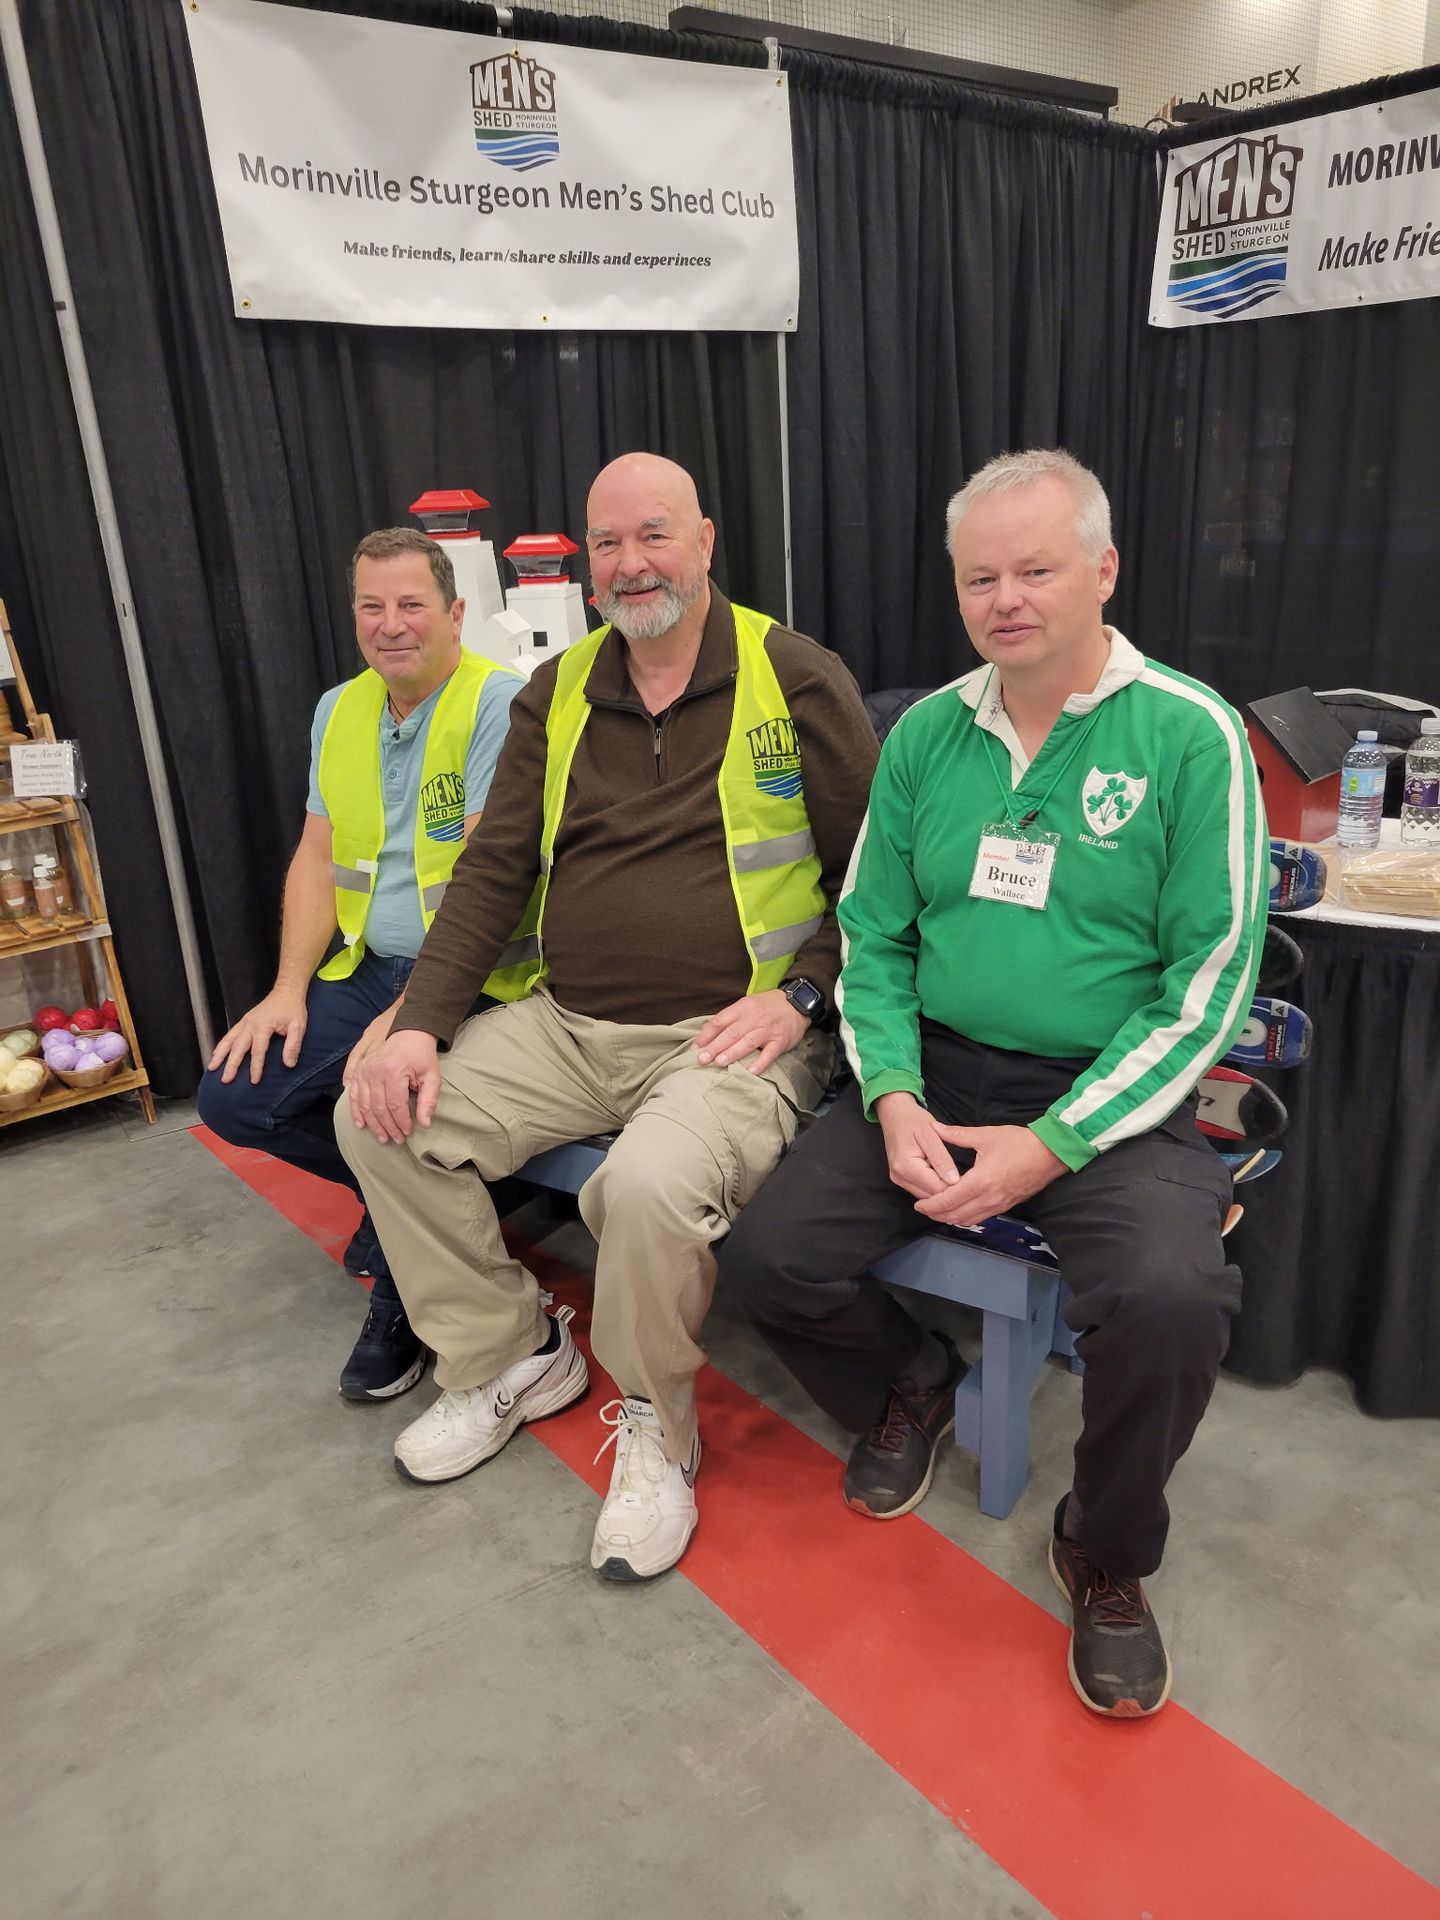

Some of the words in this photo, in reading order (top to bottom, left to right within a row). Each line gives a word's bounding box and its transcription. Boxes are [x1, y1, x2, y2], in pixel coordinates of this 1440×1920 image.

[473, 55, 554, 111] MEN'S
[473, 110, 513, 128] SHED
[515, 113, 557, 122] MORINVILLE
[516, 121, 558, 129] STURGEON
[238, 152, 401, 202] Morinville
[409, 175, 550, 215] Sturgeon
[559, 181, 643, 212] Men's
[650, 185, 715, 215] Shed
[721, 190, 775, 219] Club
[1178, 139, 1295, 231] MEN'S
[1230, 220, 1291, 239] MORINVILLE
[1172, 231, 1226, 261] SHED
[1230, 232, 1289, 251] STURGEON
[1318, 231, 1389, 272] Make
[1393, 221, 1440, 261] Frie
[343, 240, 389, 257] Make
[392, 244, 456, 264] friends,
[459, 248, 556, 264] learn/share
[558, 249, 600, 265] skills
[603, 252, 632, 266] and
[634, 253, 712, 269] experinces
[750, 718, 800, 758] MEN
[754, 757, 783, 771] SHED
[422, 773, 465, 811] MEN'S
[424, 808, 448, 823] SHED
[1078, 833, 1119, 850] IRELAND
[982, 851, 1010, 863] Member
[987, 866, 1037, 888] Bruce
[992, 887, 1026, 901] Wallace
[628, 1408, 654, 1417] ONARCH
[630, 1403, 643, 1411] AIR
